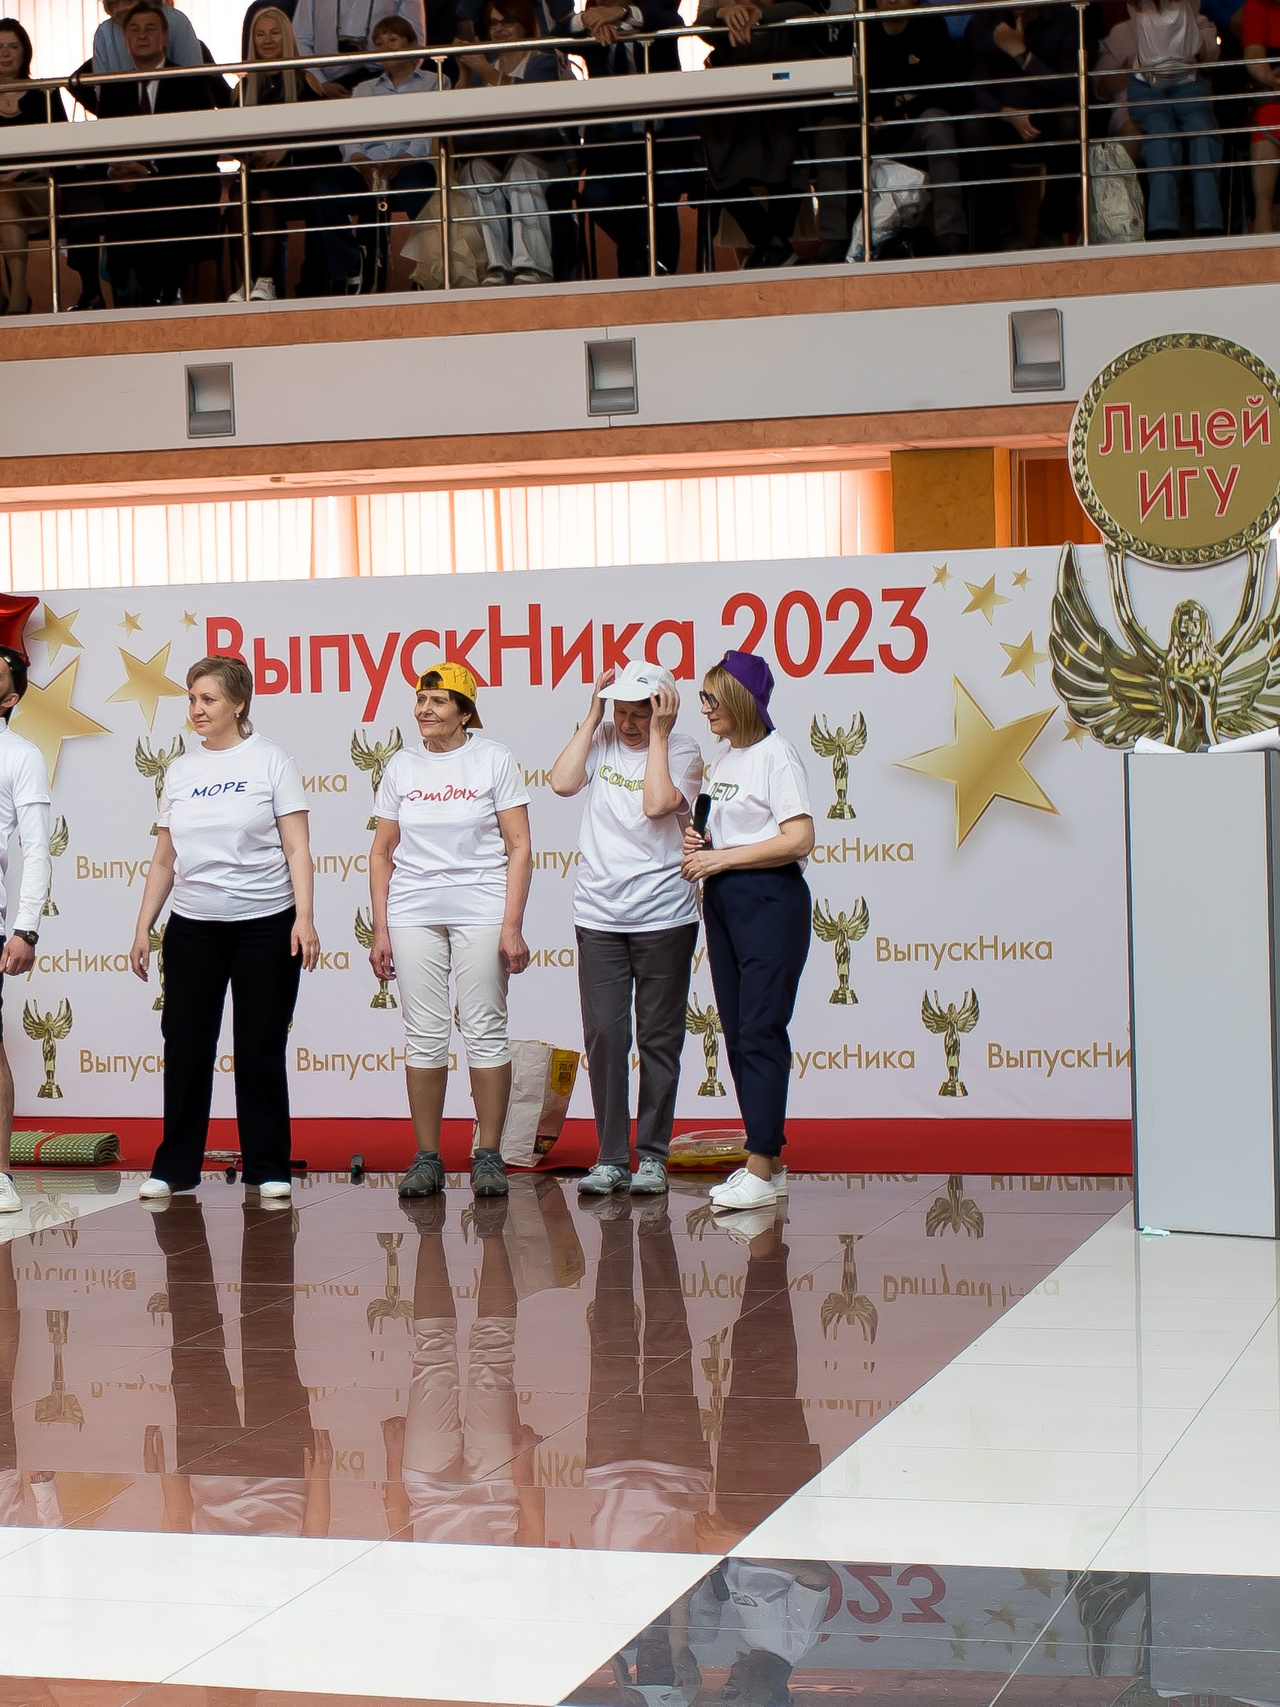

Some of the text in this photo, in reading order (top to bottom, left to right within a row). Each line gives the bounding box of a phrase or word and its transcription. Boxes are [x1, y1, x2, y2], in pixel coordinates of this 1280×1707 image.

[1099, 394, 1271, 457] Лицей
[1138, 464, 1241, 524] ИГУ
[206, 586, 929, 722] ВыпускНика 2023
[191, 781, 248, 798] МОРЕ
[810, 837, 915, 864] скНика
[875, 935, 1053, 971] ВыпускНика
[791, 1043, 916, 1080] ускНика
[987, 1042, 1132, 1079] ВыпускНи
